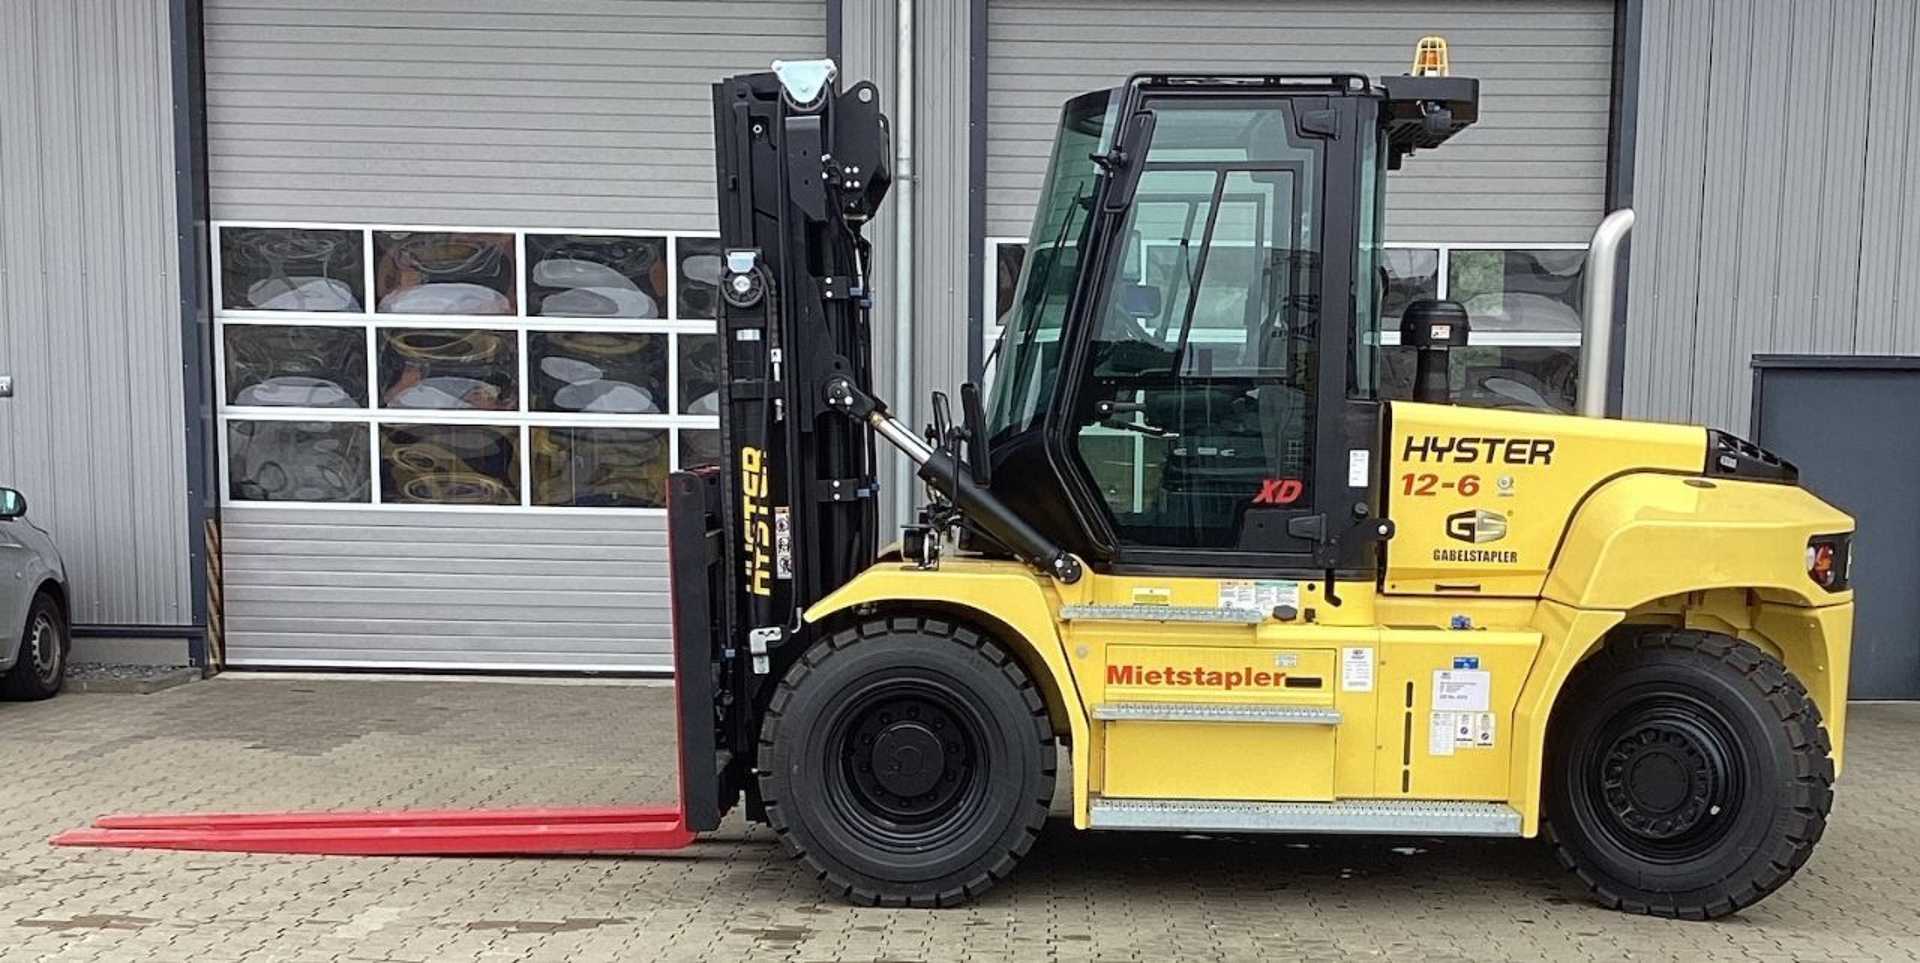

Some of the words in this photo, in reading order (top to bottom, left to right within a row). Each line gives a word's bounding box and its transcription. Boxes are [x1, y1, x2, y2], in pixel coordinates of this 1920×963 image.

[1402, 436, 1555, 465] HYSTER
[1252, 479, 1303, 504] XD
[1402, 473, 1481, 497] 12-6
[742, 446, 770, 597] HYSTER
[1446, 509, 1507, 544] GS
[1433, 549, 1518, 563] GABELSTAPLER
[1106, 665, 1288, 690] Mietstapler
